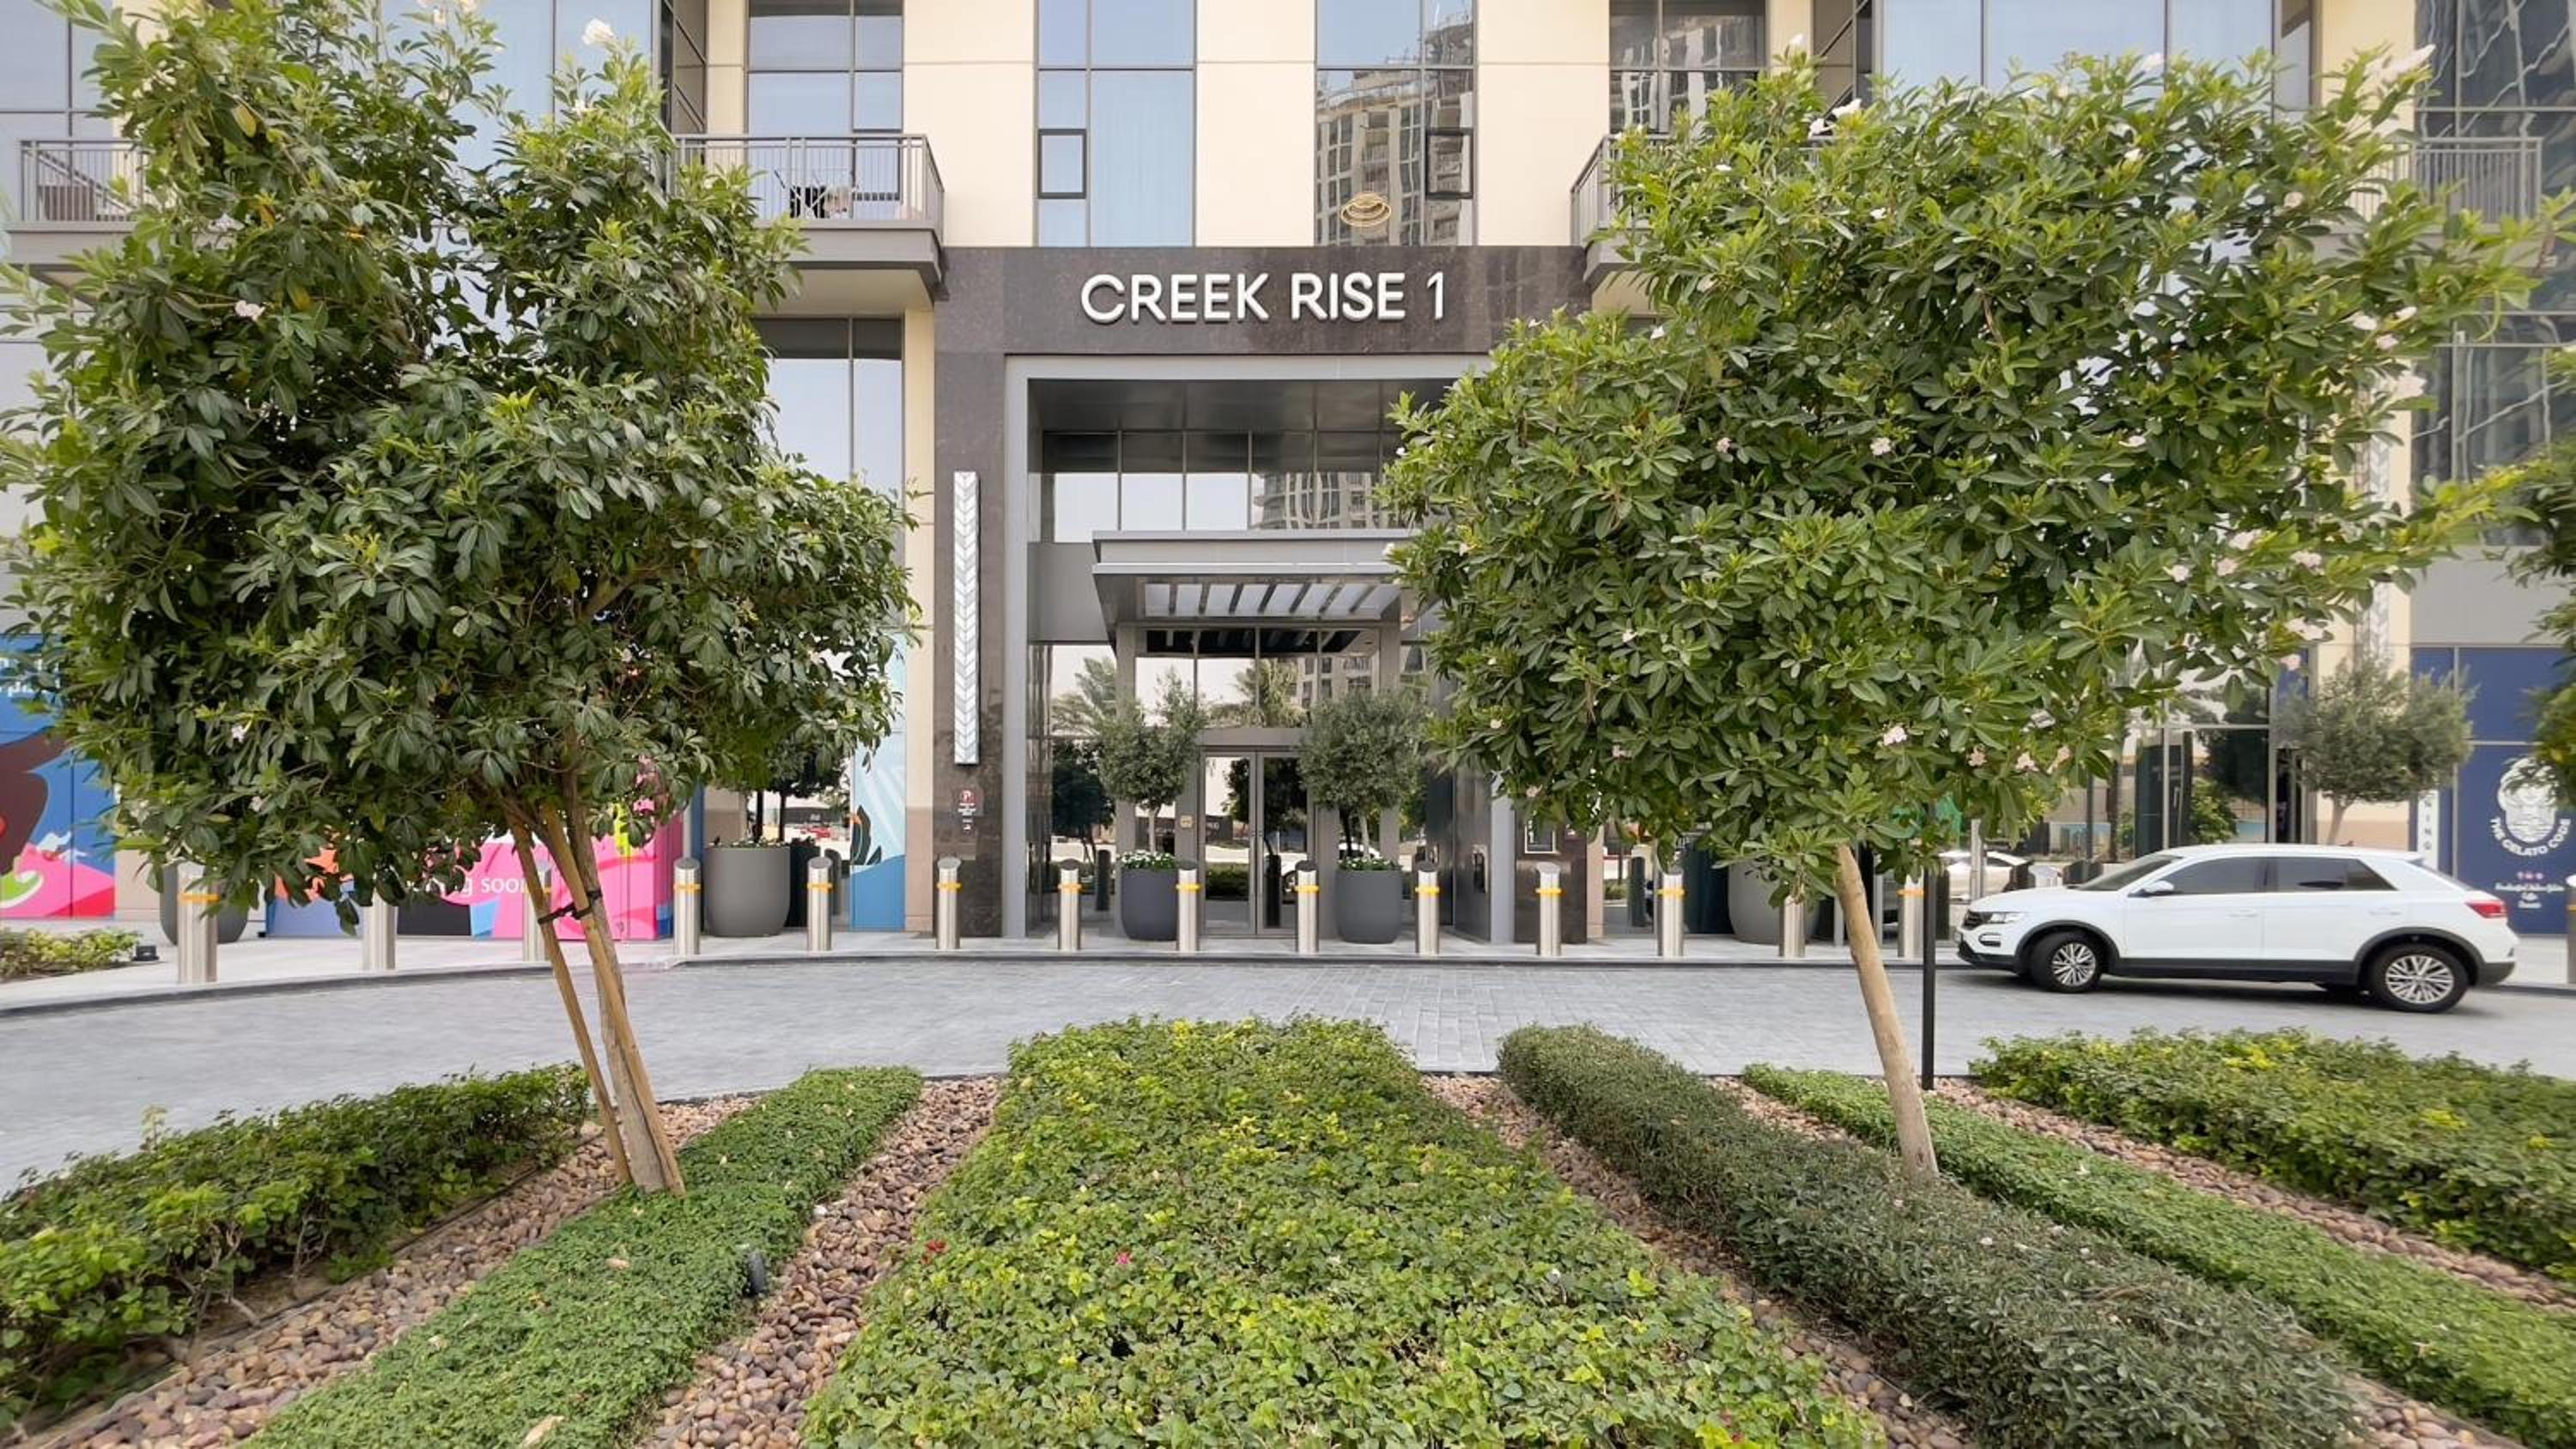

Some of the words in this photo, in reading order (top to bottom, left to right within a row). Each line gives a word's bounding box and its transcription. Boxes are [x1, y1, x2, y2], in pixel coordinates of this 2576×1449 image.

[1080, 272, 1270, 323] CREEK
[1291, 272, 1406, 321] RISE
[1425, 271, 1444, 319] 1
[2490, 817, 2506, 840] THE
[2502, 839, 2548, 856] GELATO
[2548, 818, 2572, 848] CODE
